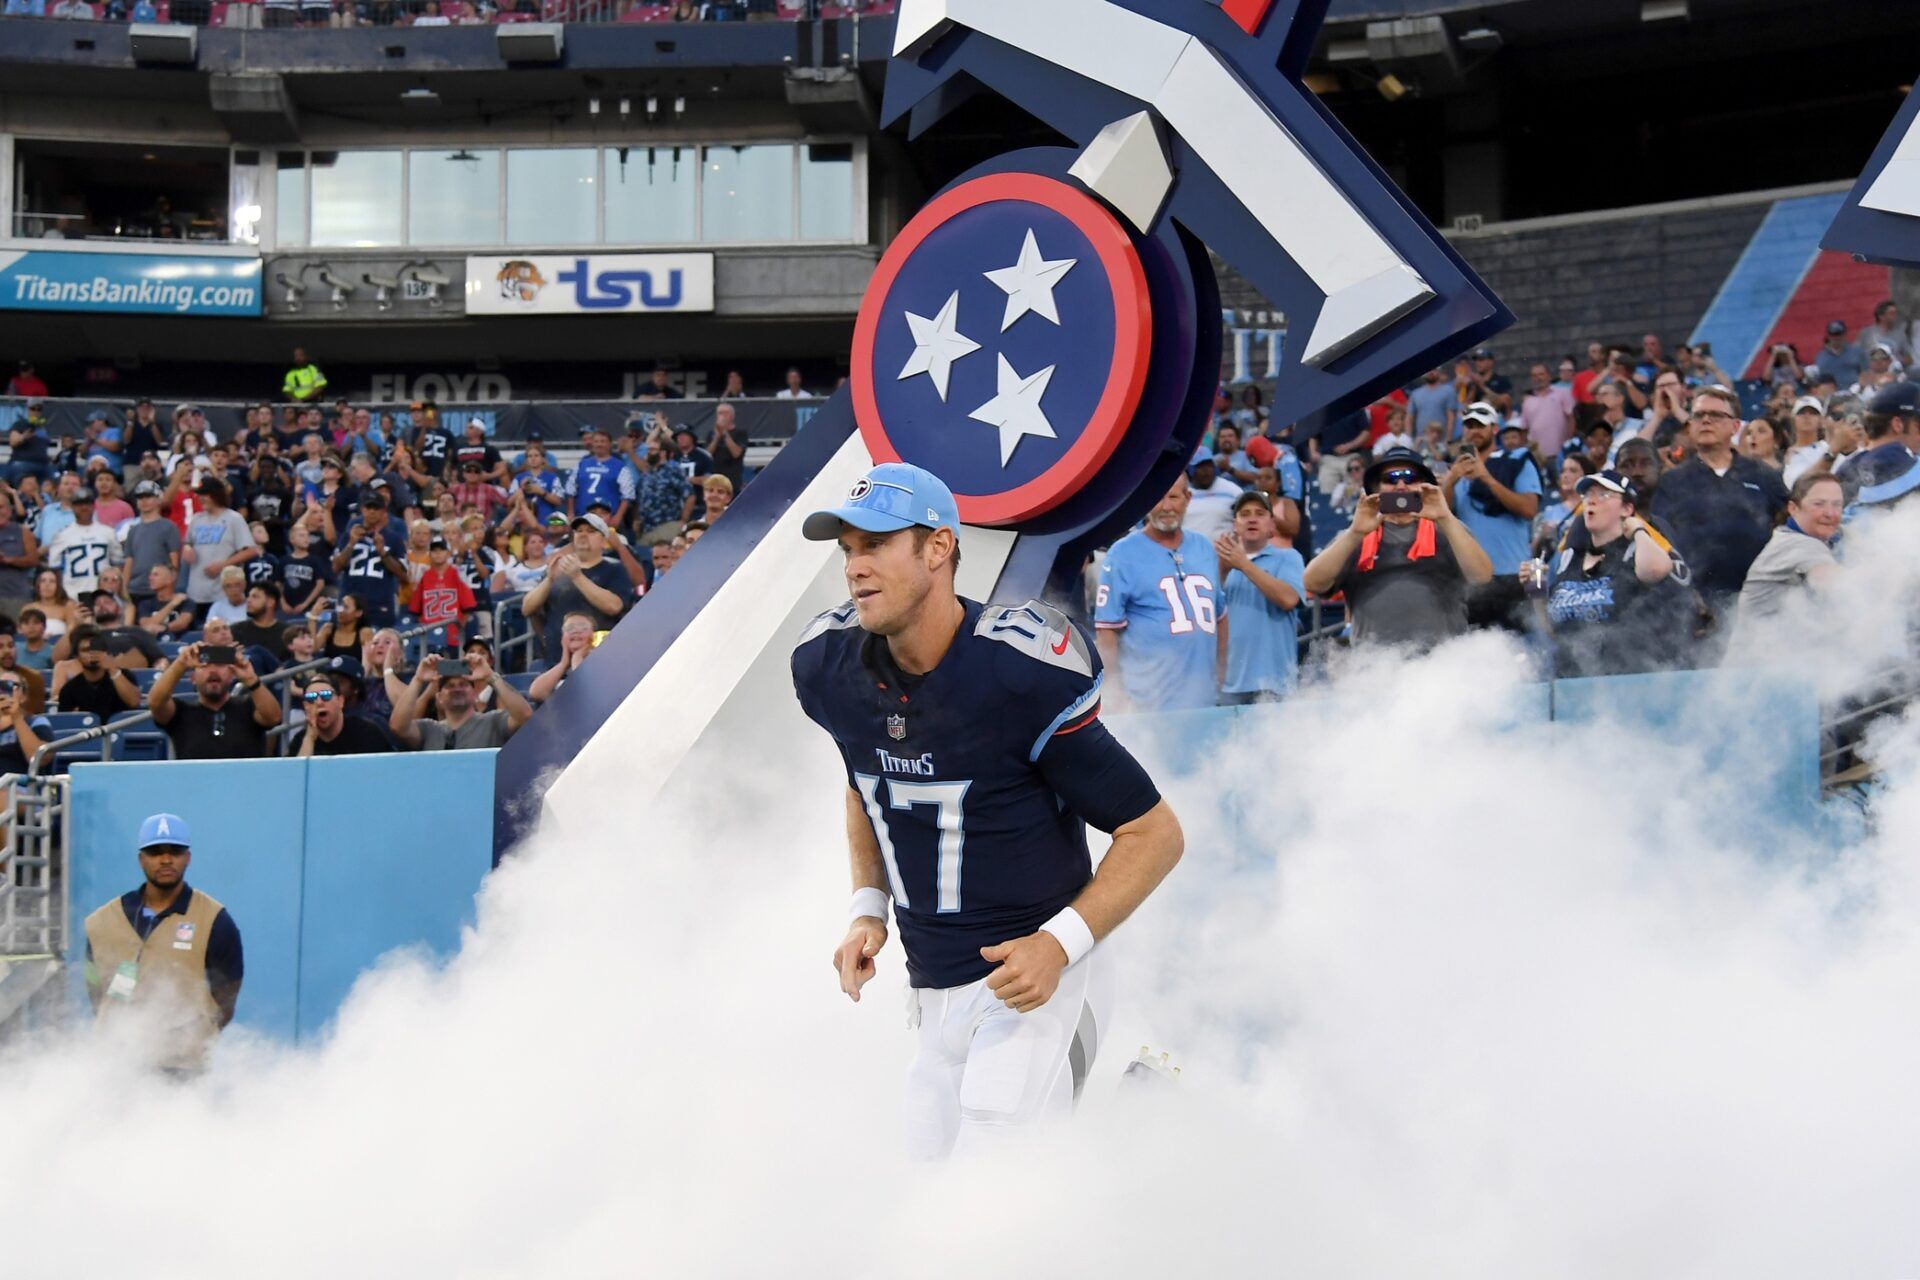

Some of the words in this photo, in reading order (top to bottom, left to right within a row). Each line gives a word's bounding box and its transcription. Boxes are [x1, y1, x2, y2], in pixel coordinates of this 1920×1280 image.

[14, 274, 254, 311] TitansBanking.com
[557, 259, 683, 308] tsu
[371, 373, 512, 401] FLOYD
[422, 433, 447, 459] 22
[587, 473, 601, 494] 7
[348, 543, 384, 579] 22
[423, 588, 458, 620] 22
[1159, 573, 1217, 635] 16
[875, 747, 935, 776] TITANS
[854, 771, 974, 914] 17
